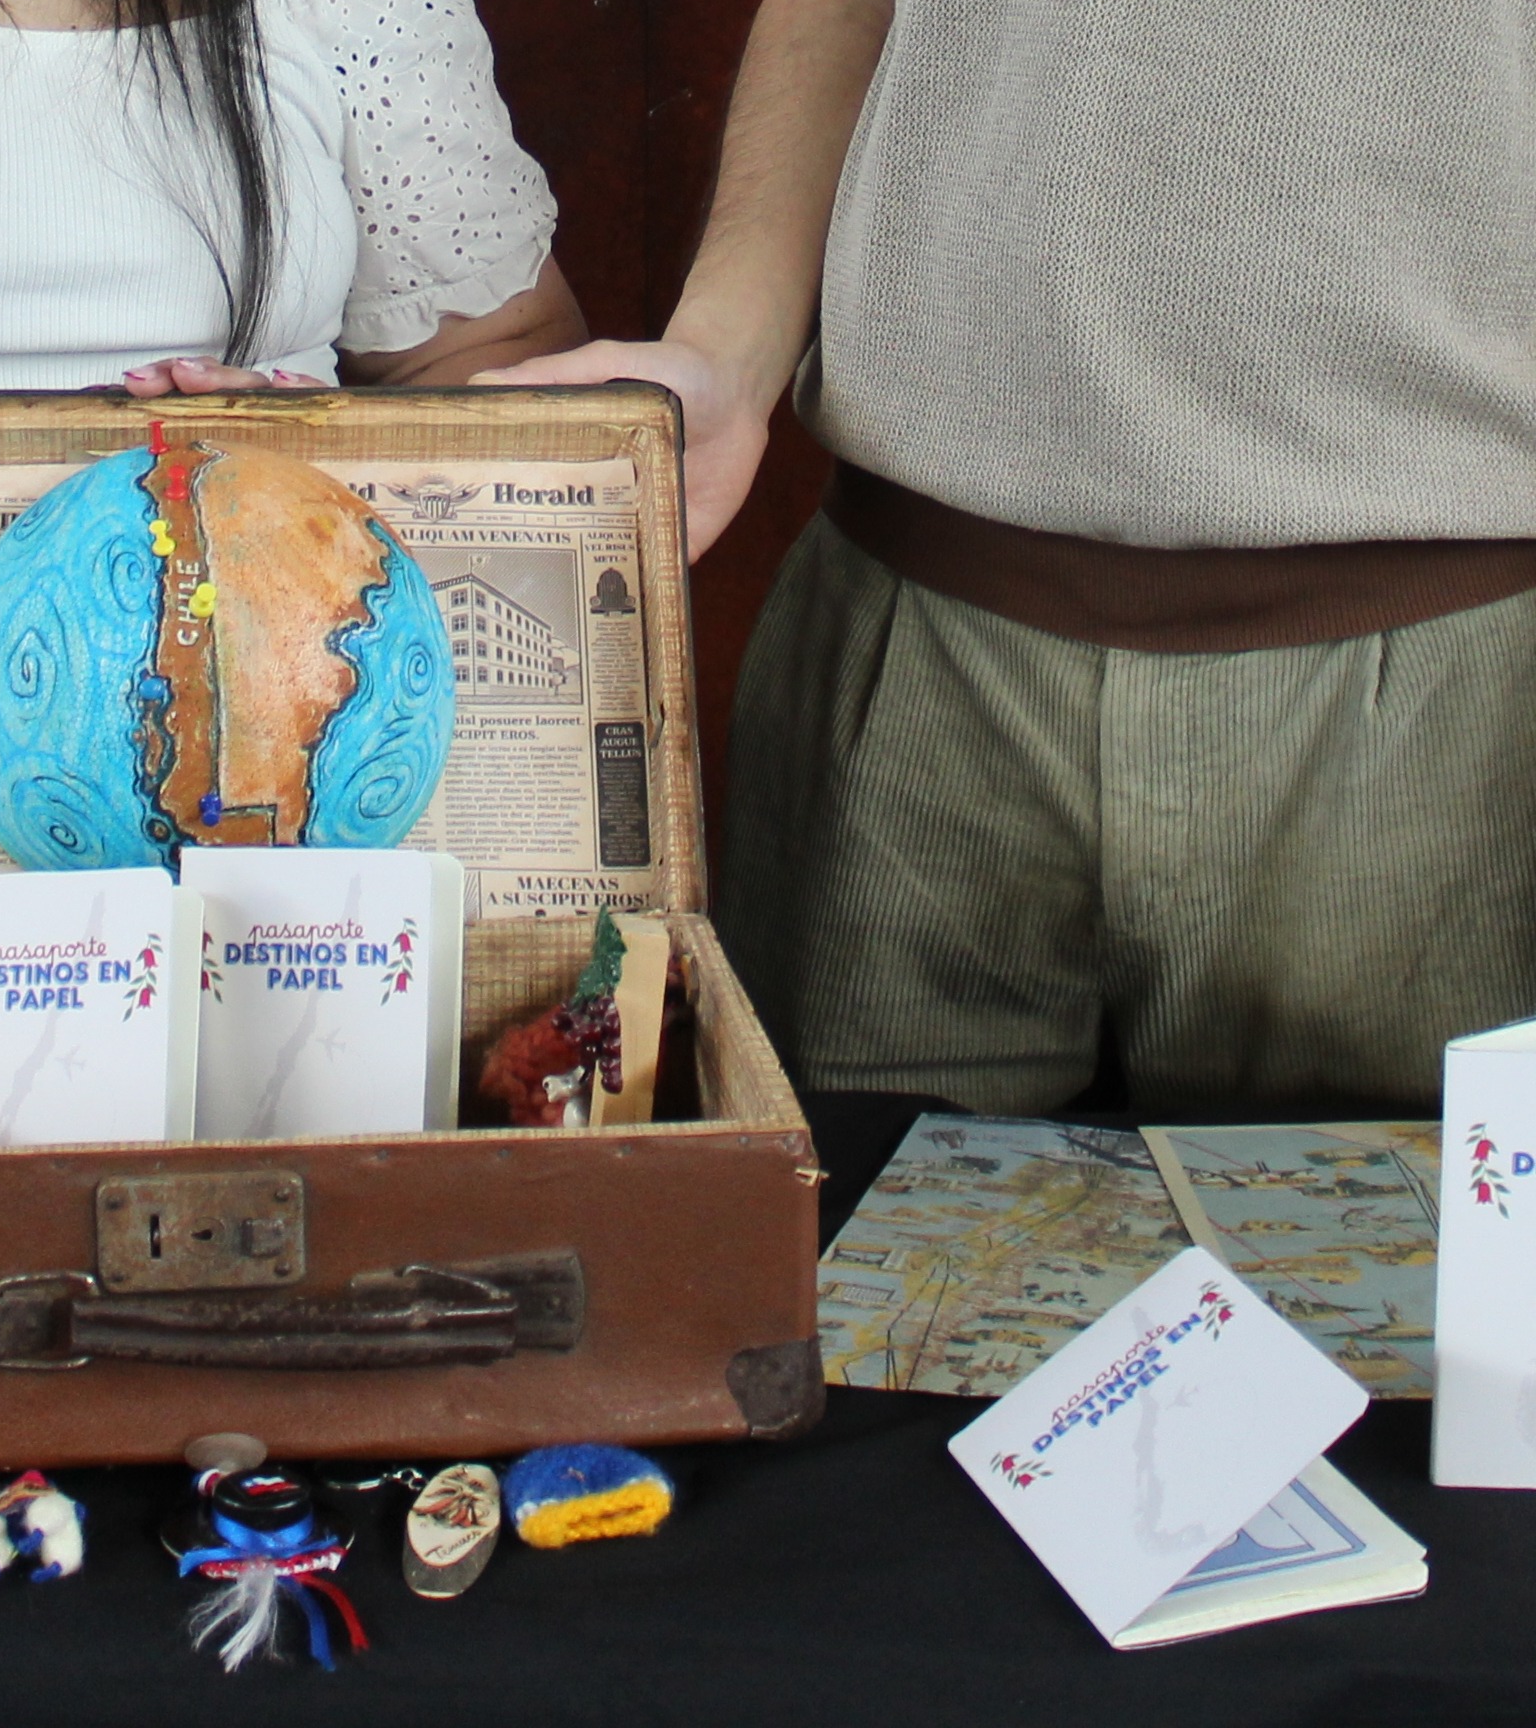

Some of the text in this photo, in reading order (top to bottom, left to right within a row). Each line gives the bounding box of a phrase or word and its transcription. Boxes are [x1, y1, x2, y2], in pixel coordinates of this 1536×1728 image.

[492, 483, 596, 506] Herald
[399, 528, 572, 544] ALIQUAM VENENATIS
[586, 531, 633, 541] ALIQUAM
[593, 554, 628, 564] METUS
[480, 716, 532, 728] posuere
[535, 715, 585, 726] laoreet.
[452, 730, 540, 740] SCIPIT EROS.
[604, 726, 634, 735] CRAS
[601, 737, 639, 747] AUGUE
[599, 748, 642, 758] TELLUS
[517, 876, 620, 891] MAECENAS
[487, 892, 651, 908] A SUSCIPIT EROS!
[248, 918, 366, 948] pasaporte
[223, 942, 389, 967] DESTINOS EN
[97, 960, 132, 984] EN
[266, 968, 344, 991] PAPEL
[5, 987, 85, 1012] PAPEL
[1051, 1324, 1167, 1424] pasaporte
[1031, 1312, 1203, 1454] DESTINOS EN
[1086, 1364, 1171, 1428] PAPEL
